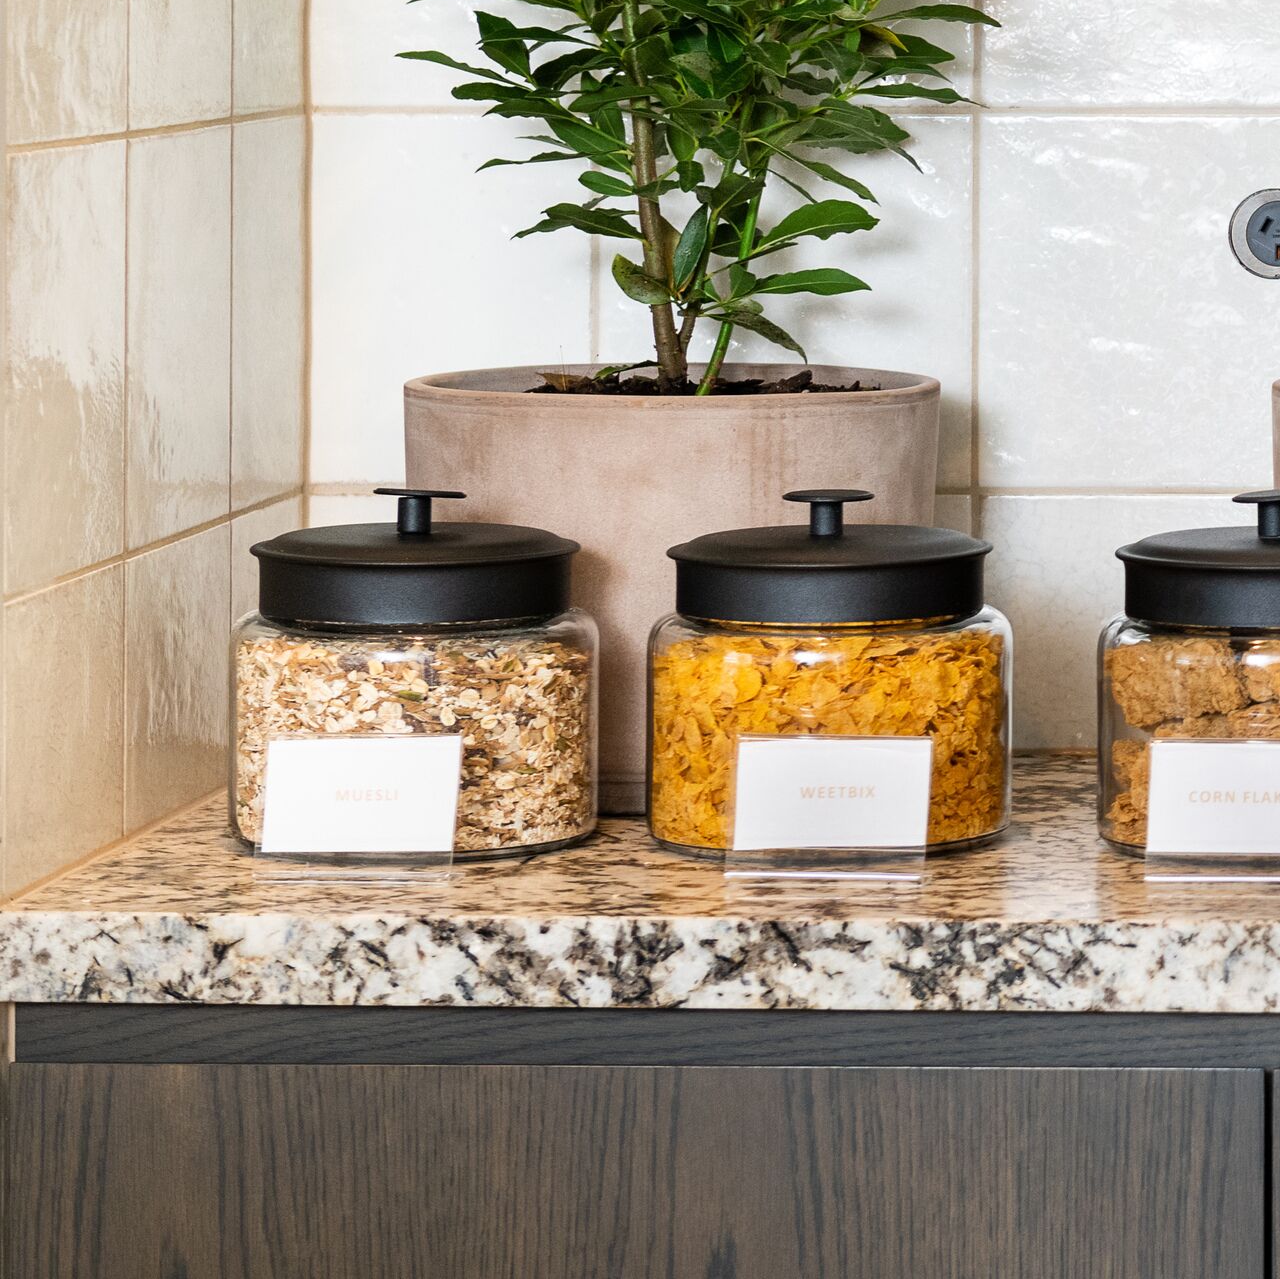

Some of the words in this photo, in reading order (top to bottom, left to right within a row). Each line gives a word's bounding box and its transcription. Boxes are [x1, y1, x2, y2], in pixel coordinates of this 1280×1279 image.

[335, 788, 399, 802] MUESLI
[799, 785, 876, 800] WEETBIX
[1188, 790, 1236, 804] CORN
